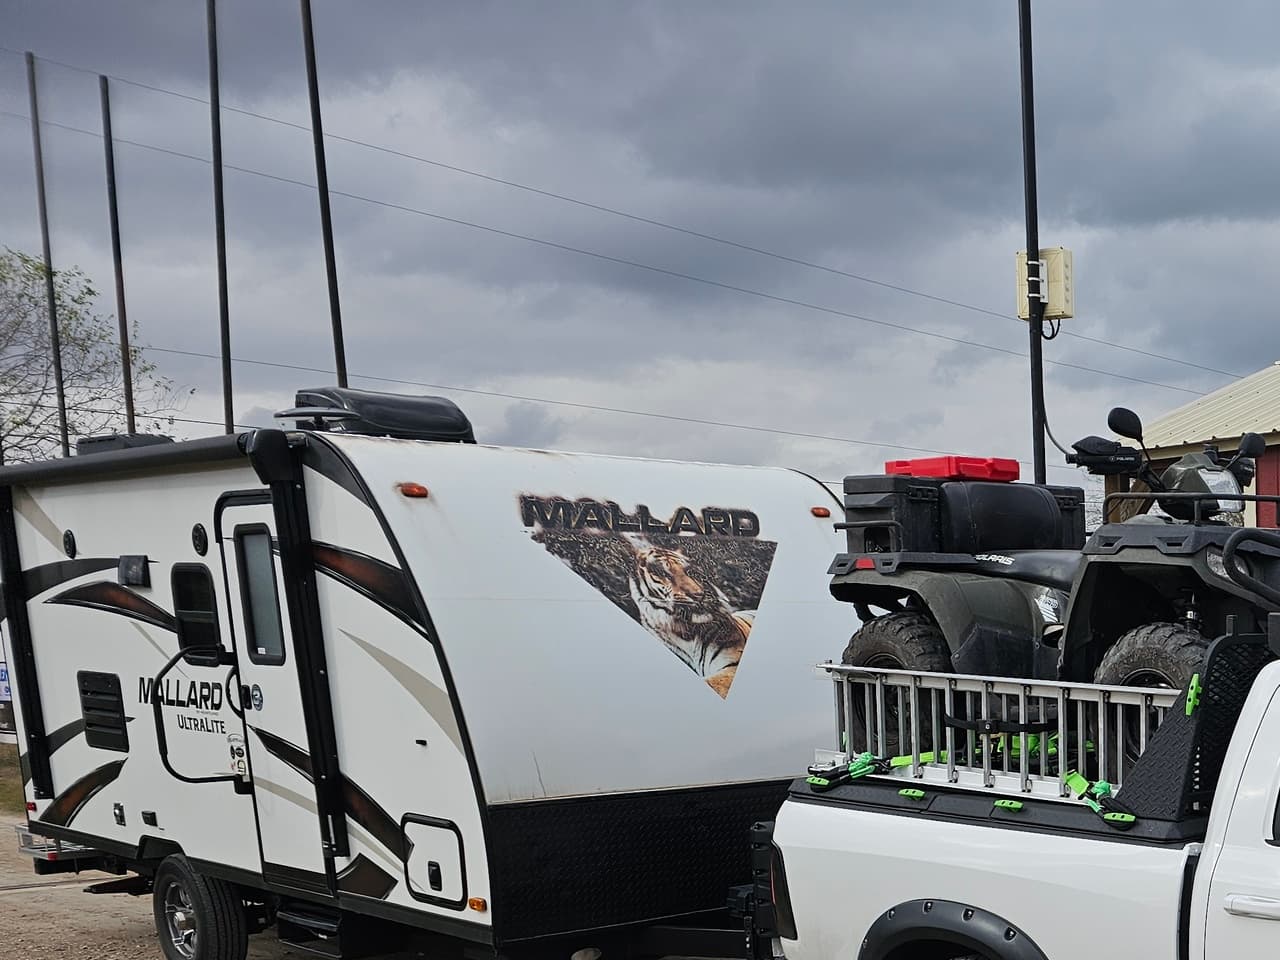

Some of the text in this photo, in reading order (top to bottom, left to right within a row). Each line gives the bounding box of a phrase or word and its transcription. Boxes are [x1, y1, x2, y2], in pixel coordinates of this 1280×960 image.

[519, 496, 761, 537] MALLARD
[974, 554, 1016, 566] OLARIS
[138, 676, 223, 711] MALLARD
